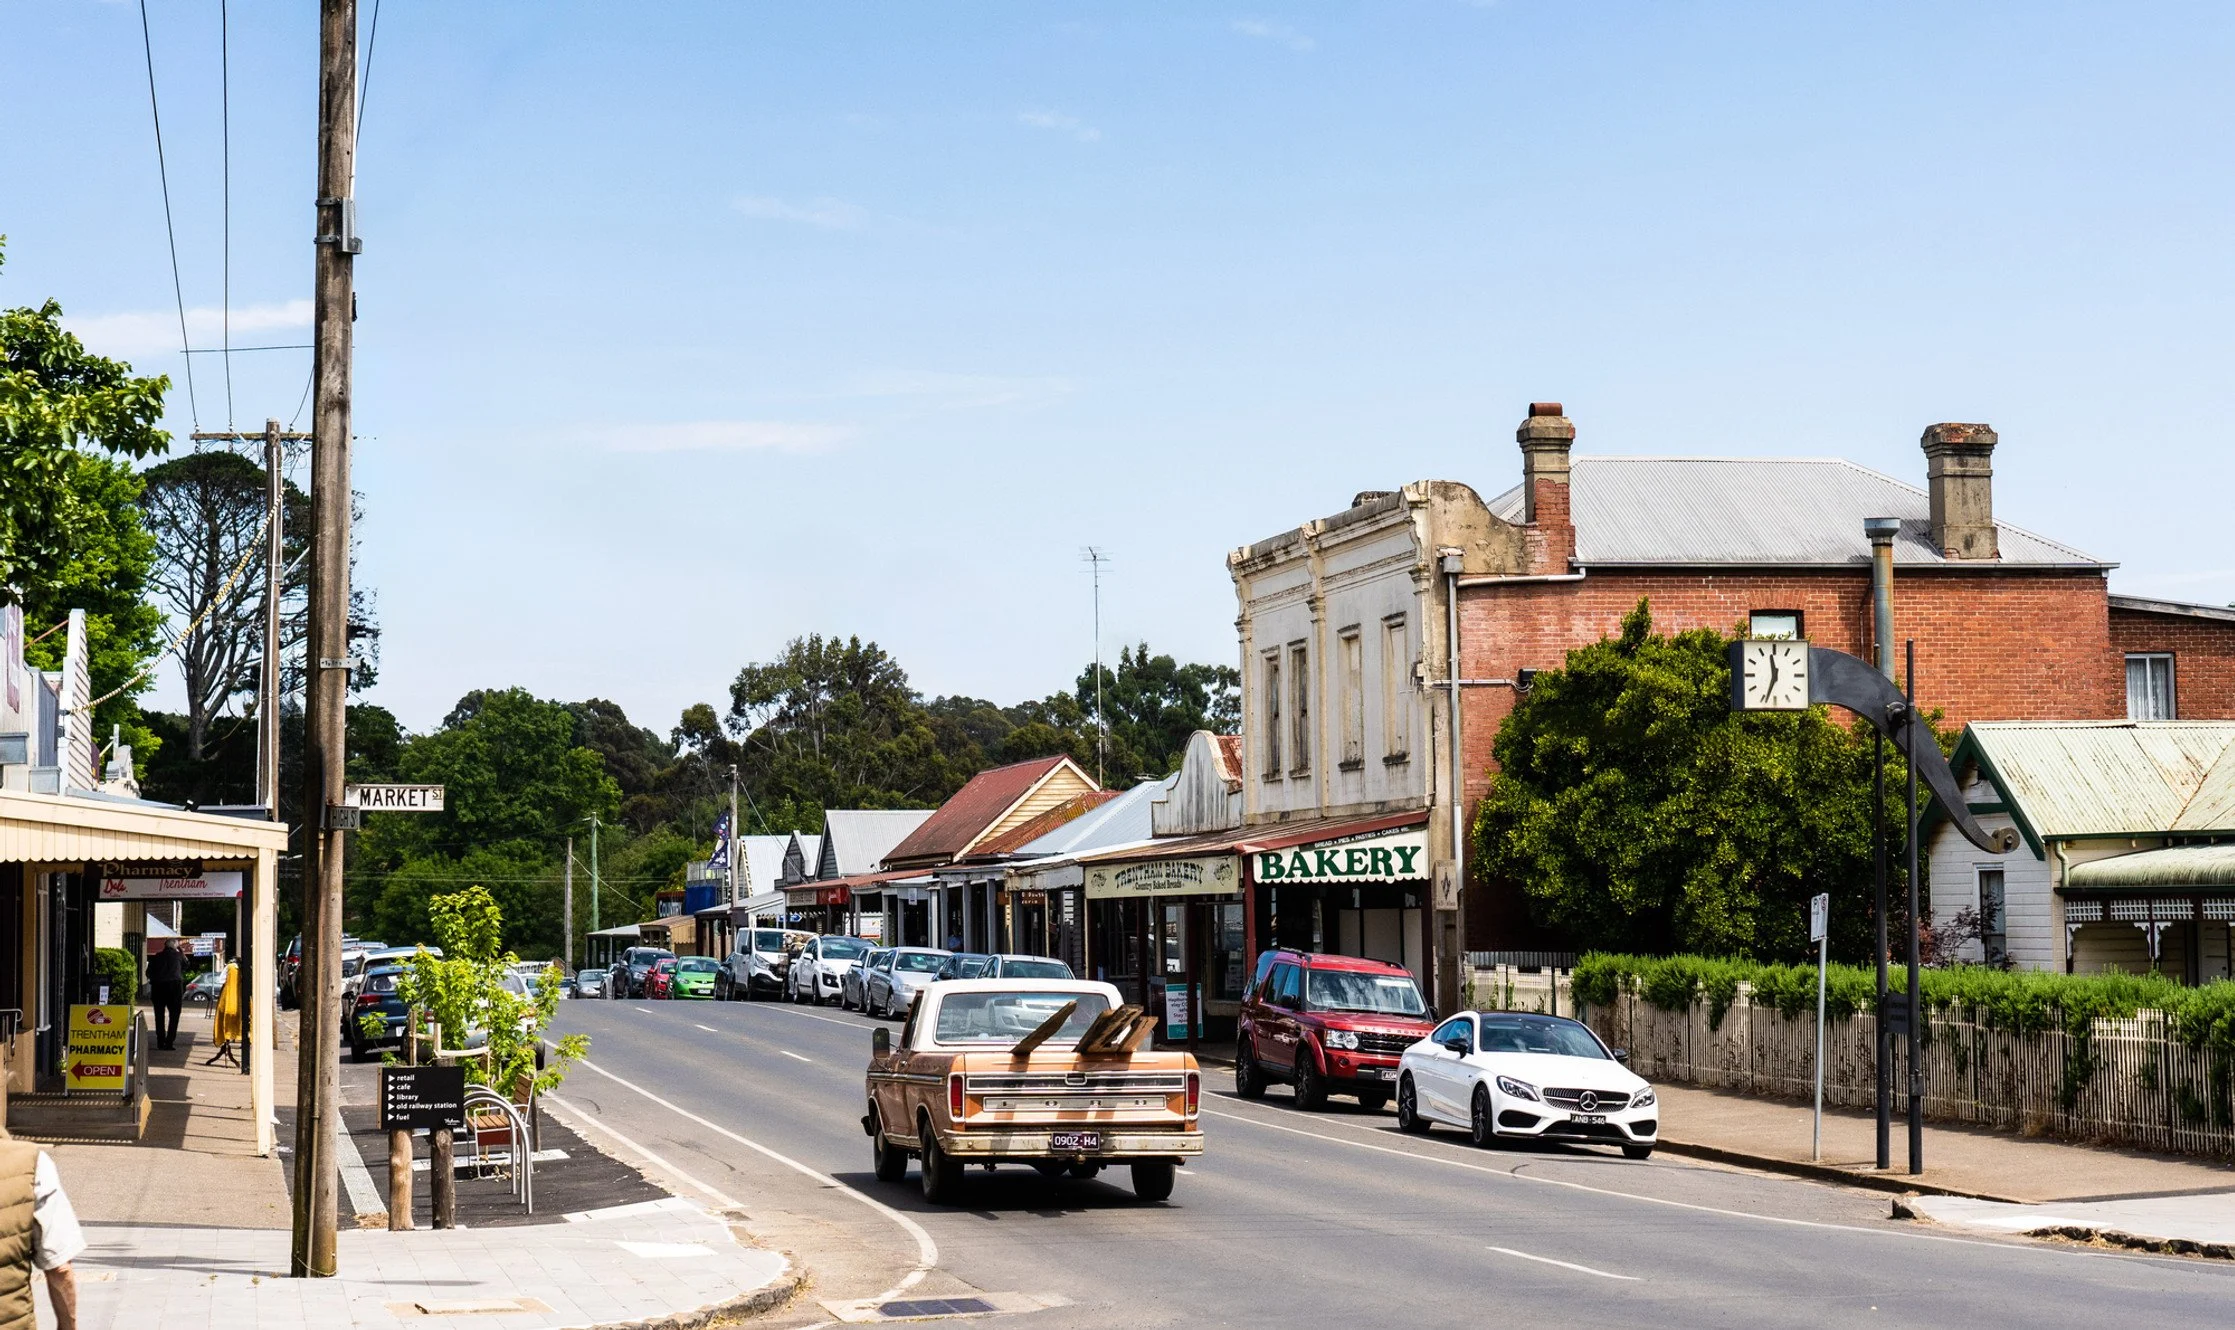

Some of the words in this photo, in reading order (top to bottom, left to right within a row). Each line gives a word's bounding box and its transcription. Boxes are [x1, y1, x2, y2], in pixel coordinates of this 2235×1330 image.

[360, 788, 429, 807] MARKET
[432, 788, 443, 799] ST
[1355, 831, 1376, 842] PASTIES
[1381, 827, 1400, 836] CAKES
[1258, 845, 1422, 880] BAKERY
[97, 861, 193, 879] Pharmacy
[1114, 862, 1163, 889] TRENTHAM
[1165, 861, 1204, 885] BAKERY
[1135, 881, 1152, 891] Country
[70, 1029, 126, 1040] TRENTHAM
[69, 1045, 124, 1055] PHARMACY
[83, 1066, 116, 1076] OPEN
[396, 1083, 411, 1091] cafe
[396, 1093, 419, 1102] library
[396, 1102, 408, 1110] old
[409, 1102, 432, 1111] railway
[434, 1101, 457, 1109] station
[396, 1113, 410, 1121] fuel
